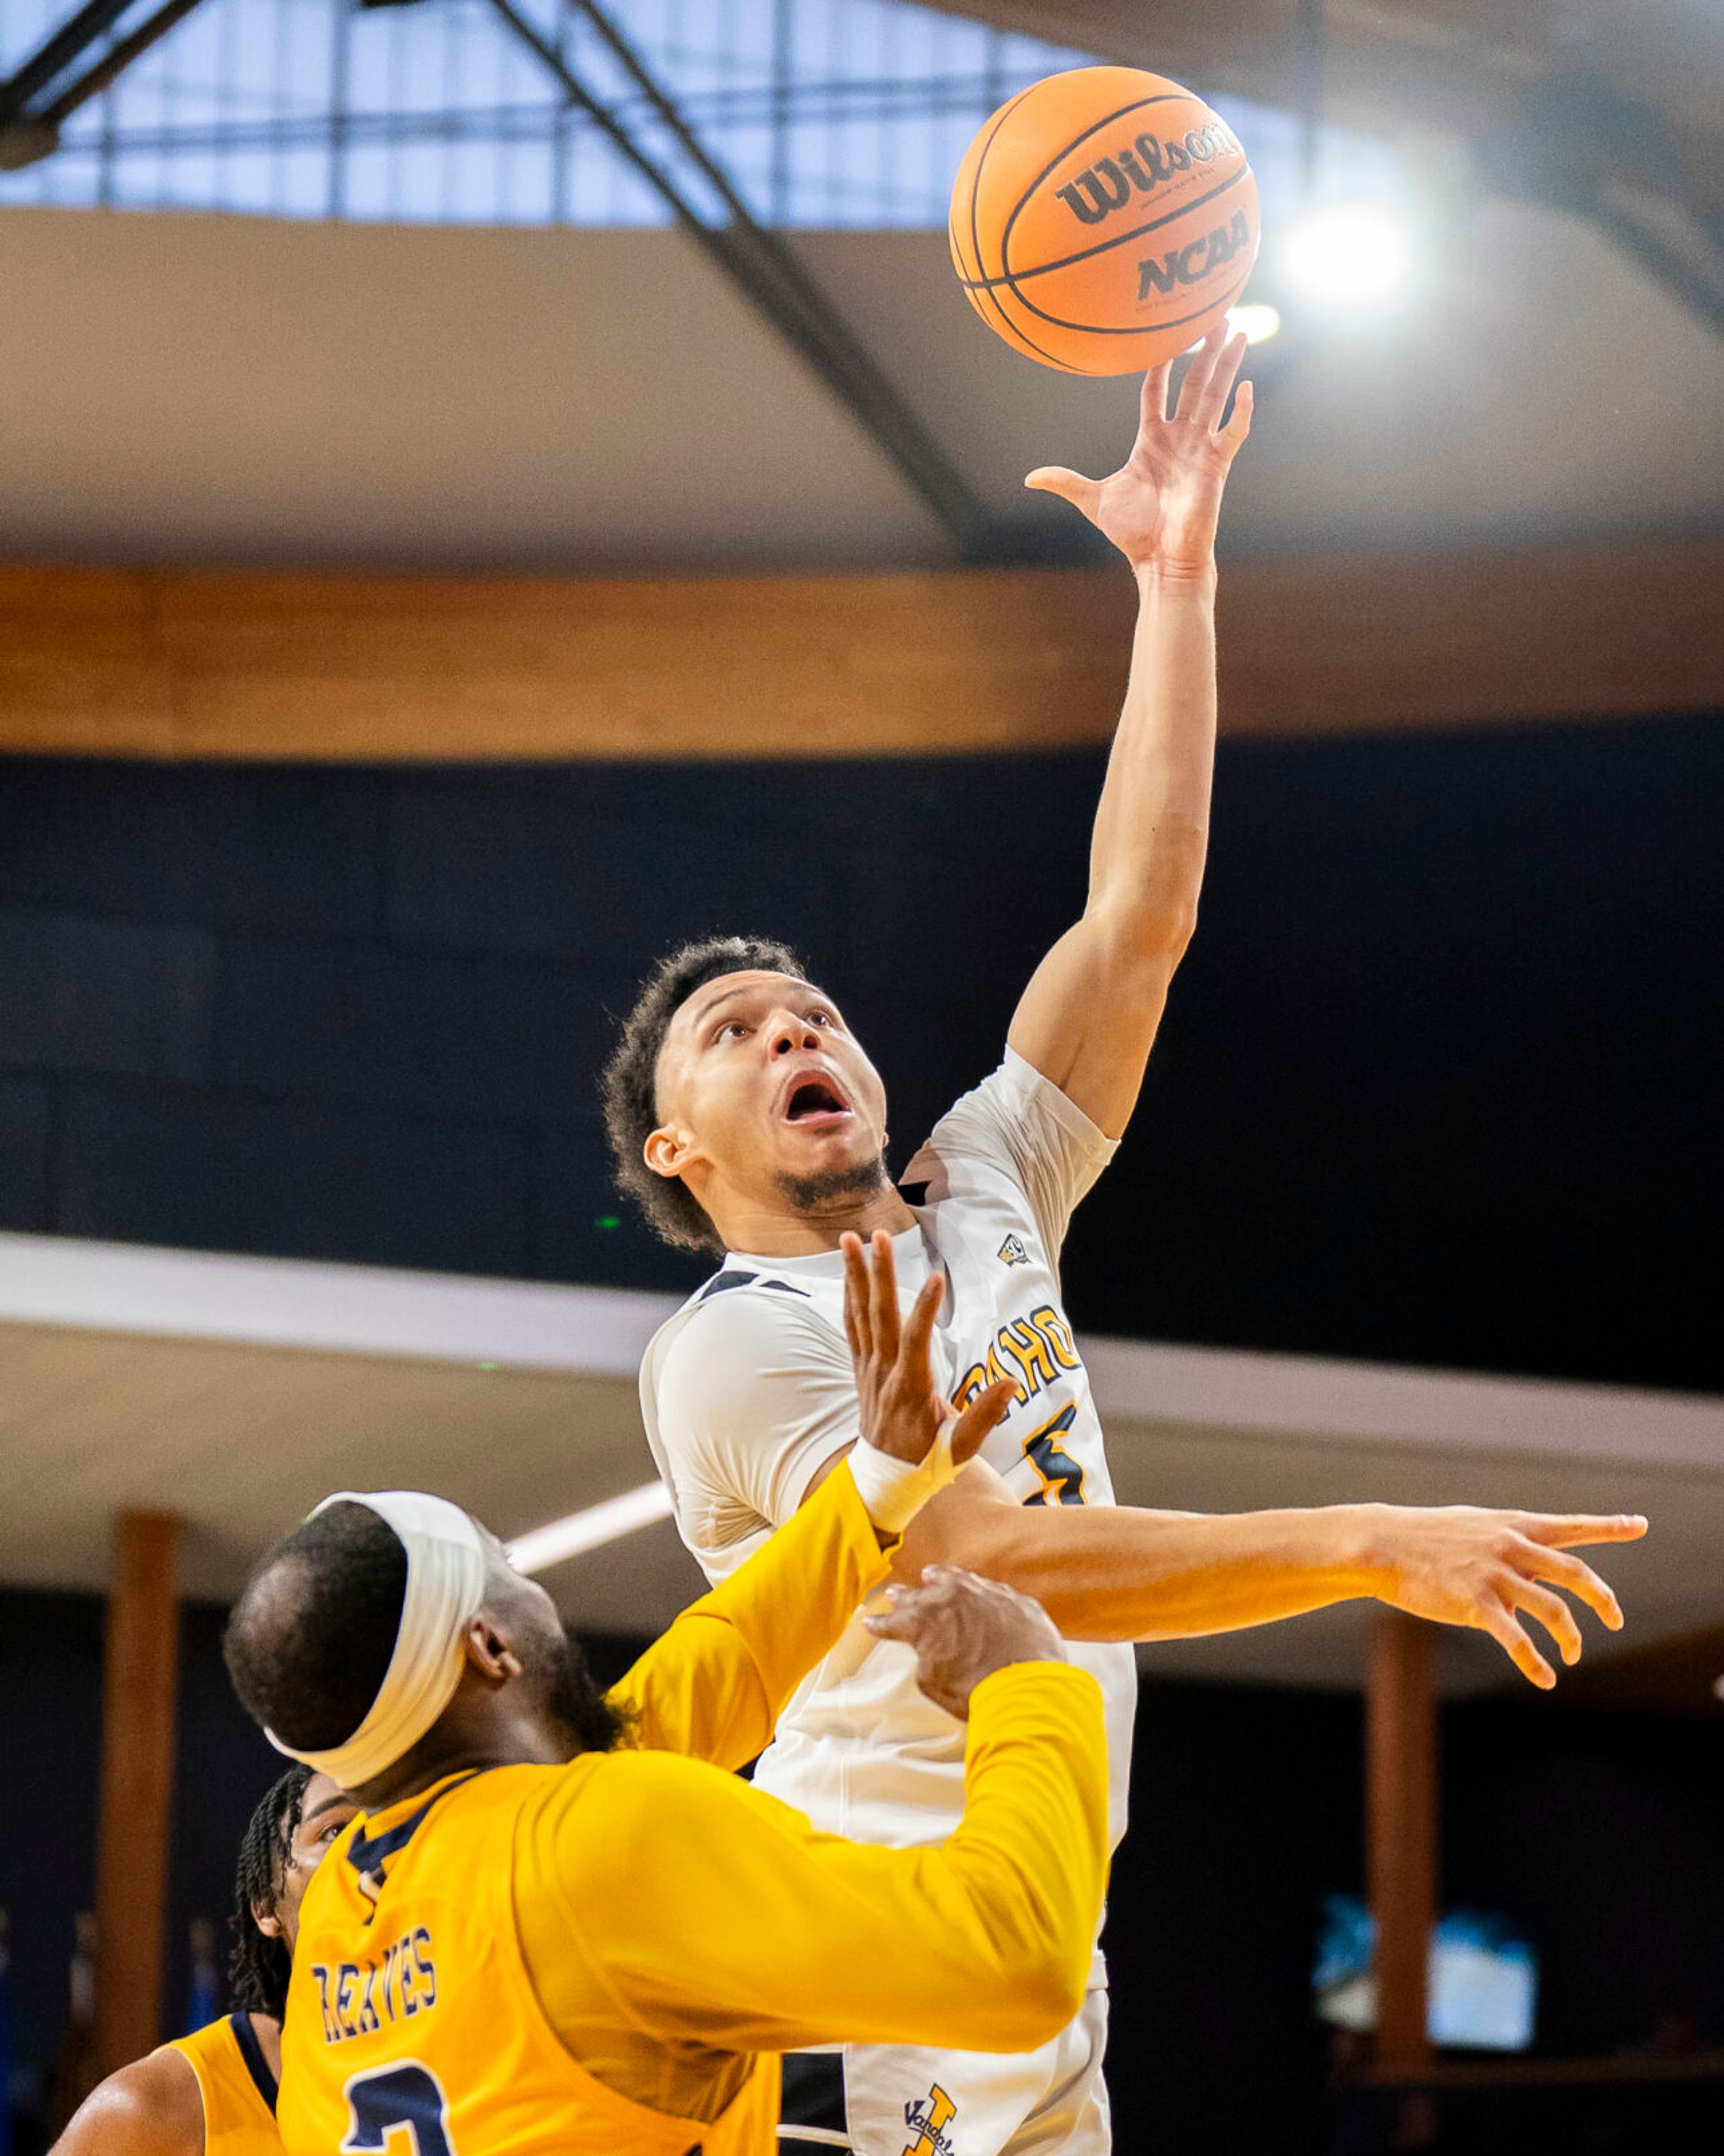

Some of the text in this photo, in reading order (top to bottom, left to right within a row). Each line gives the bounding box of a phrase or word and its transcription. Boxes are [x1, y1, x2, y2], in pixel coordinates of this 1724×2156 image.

[1055, 124, 1238, 224] Wilson
[1138, 209, 1249, 300] NCAA
[311, 1926, 438, 2045] REAVES
